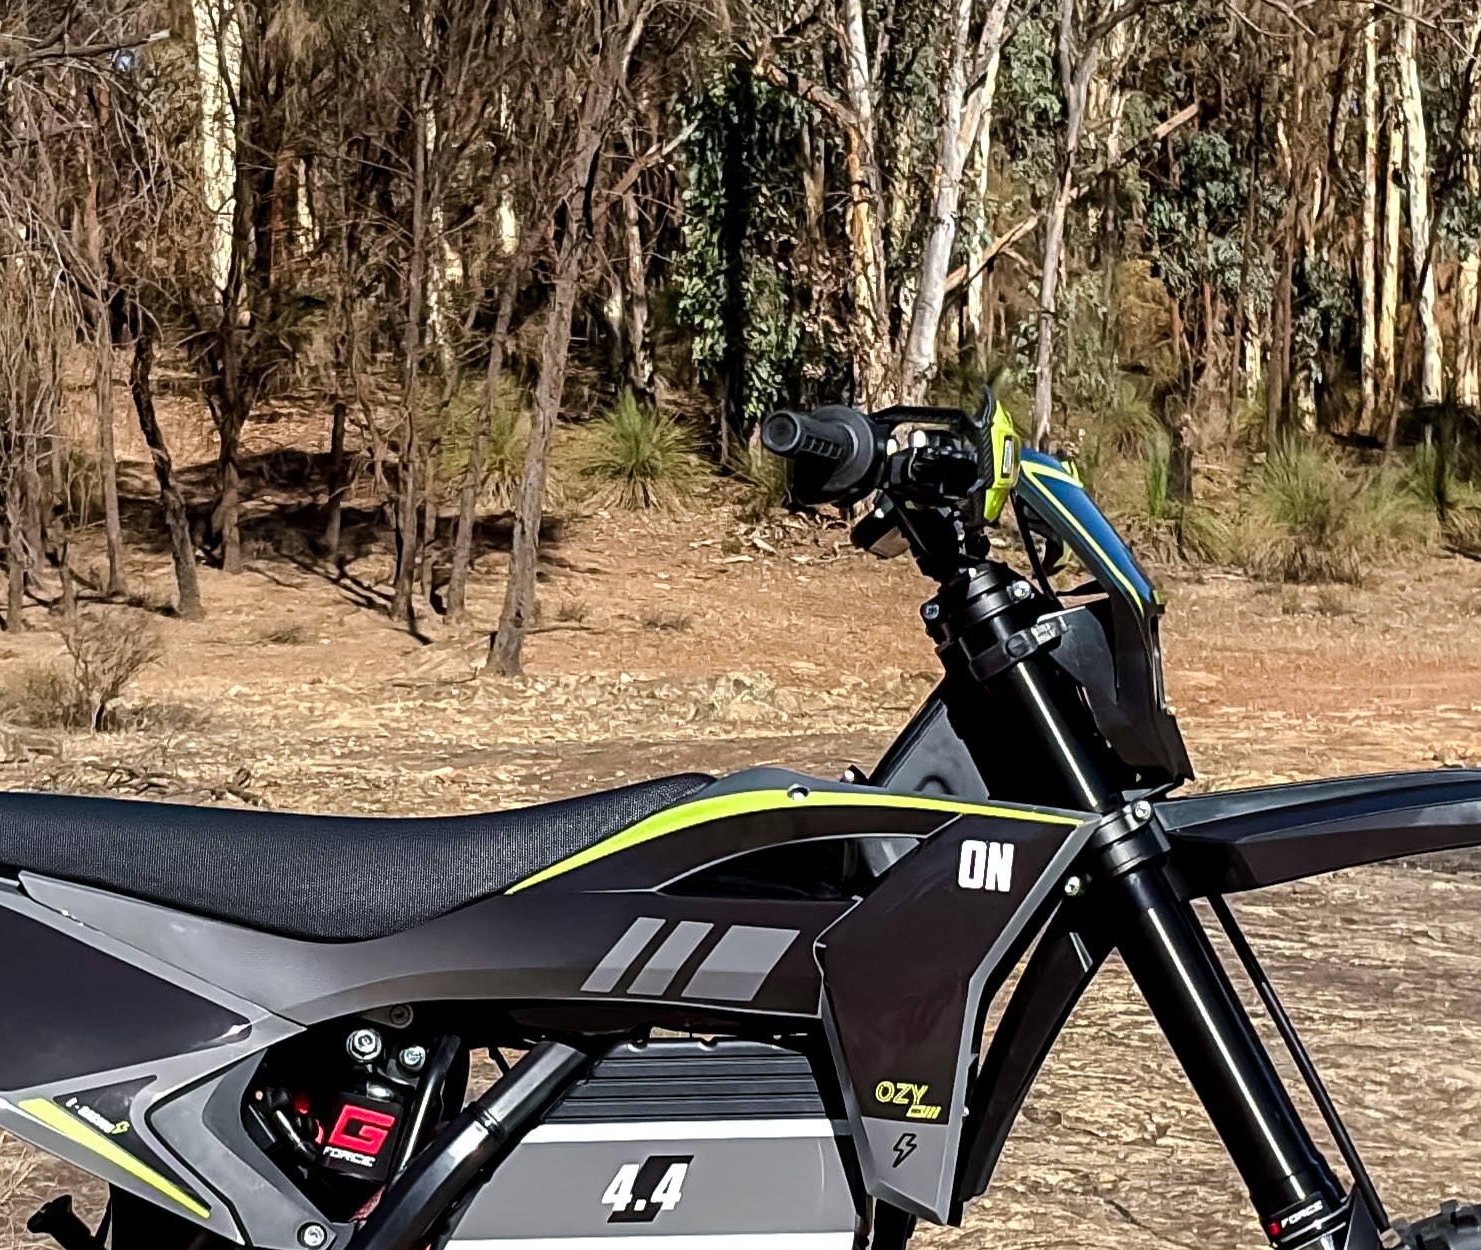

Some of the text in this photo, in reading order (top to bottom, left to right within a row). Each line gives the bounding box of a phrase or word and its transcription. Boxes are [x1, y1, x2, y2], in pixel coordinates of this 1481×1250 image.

[958, 840, 1015, 892] ON
[875, 1081, 928, 1105] OZY
[328, 1104, 396, 1155] G
[323, 1146, 376, 1167] FORCE
[601, 1164, 689, 1212] 4.4
